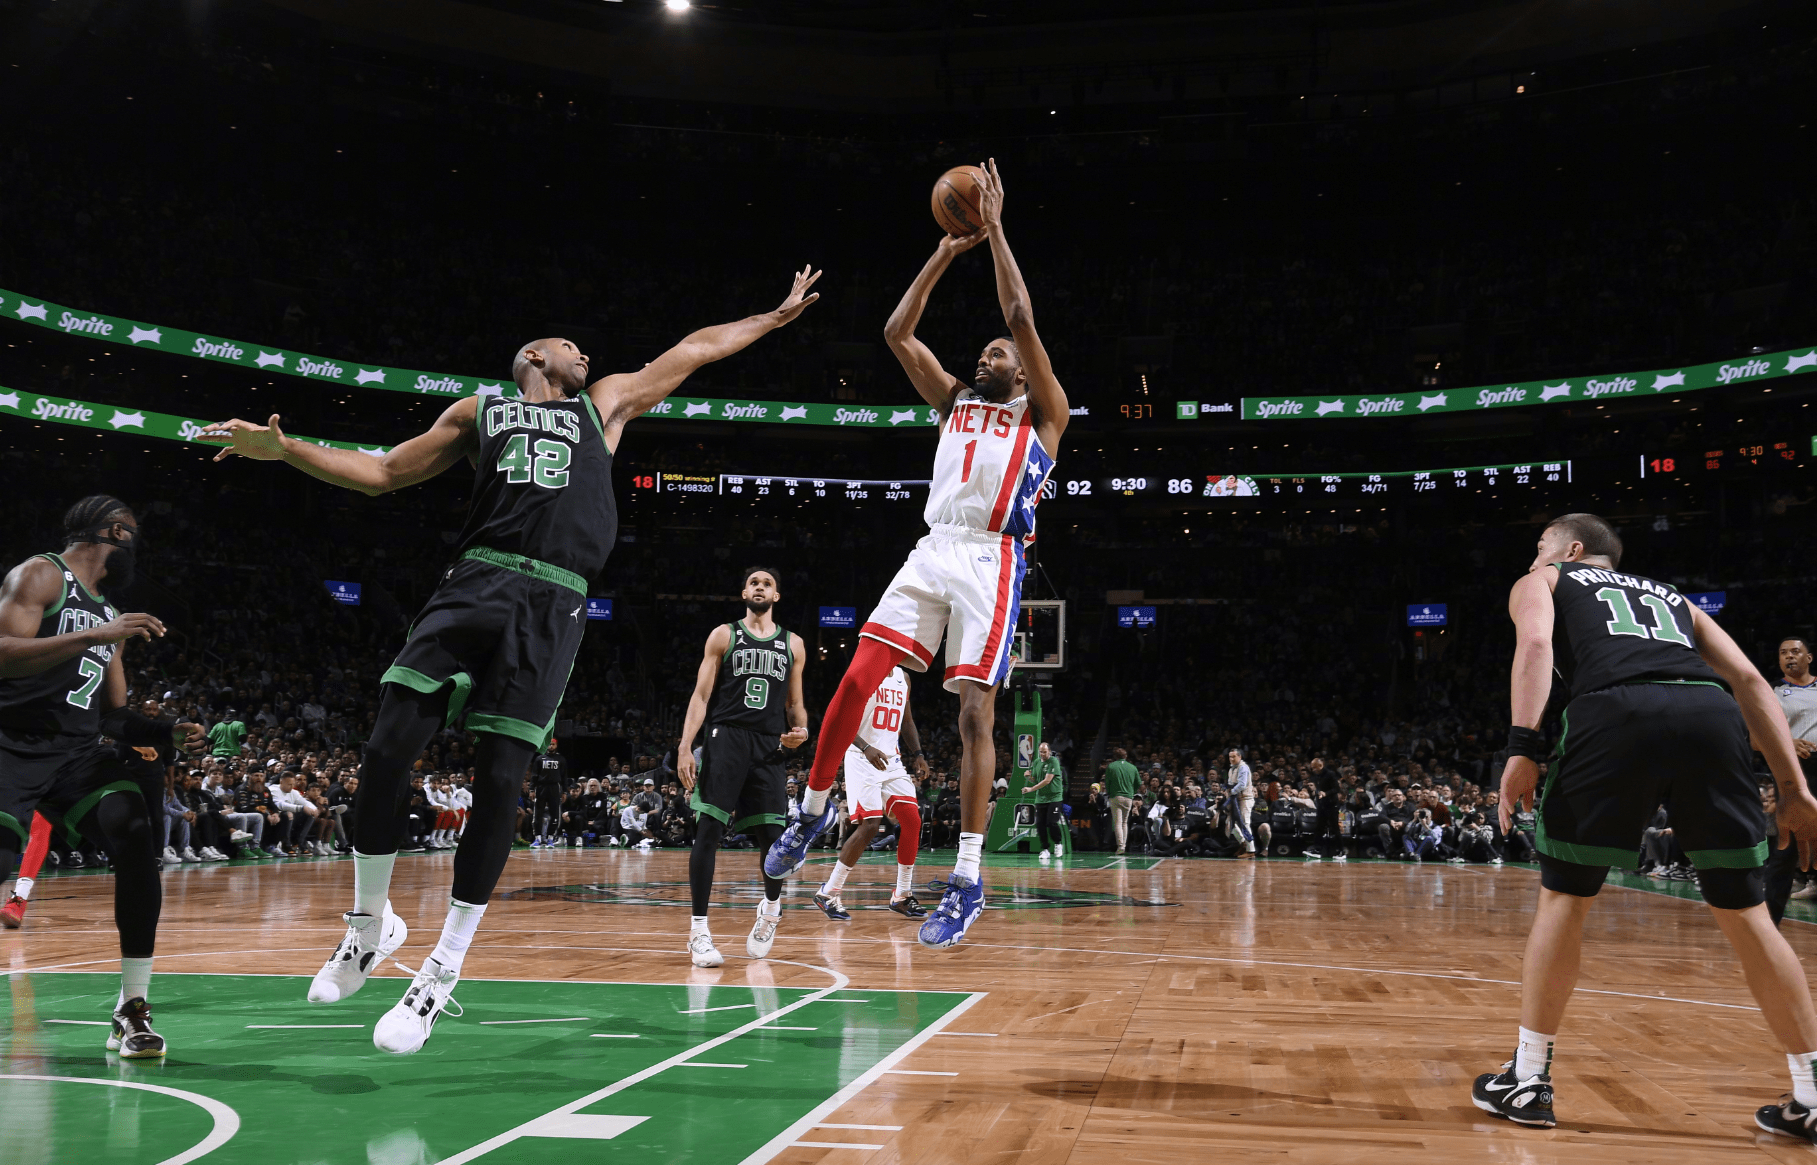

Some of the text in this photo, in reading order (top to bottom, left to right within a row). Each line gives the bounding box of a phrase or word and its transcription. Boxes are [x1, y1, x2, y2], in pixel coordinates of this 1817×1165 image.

[58, 311, 113, 336] Sprite
[192, 337, 243, 360] Sprite
[295, 357, 344, 379] Sprite
[1716, 359, 1771, 384] Sprite
[414, 374, 464, 394] Sprite
[1583, 377, 1637, 398] Sprite
[1355, 397, 1405, 416] Sprite
[1475, 387, 1527, 407] Sprite
[31, 398, 94, 422] Sprite
[721, 402, 768, 420] Sprite
[833, 408, 879, 425] Sprite
[1069, 406, 1090, 416] ank
[1120, 404, 1152, 418] 9:37
[1181, 403, 1234, 416] TD Bank
[1255, 400, 1304, 418] Sprite
[486, 402, 580, 444] CELTICS
[949, 404, 1014, 439] NETS
[496, 433, 572, 489] 42
[960, 439, 978, 483] 1
[1739, 445, 1764, 457] 9:30
[1321, 475, 1342, 483] FG%
[1369, 474, 1382, 483] FG
[1414, 472, 1430, 480] 3PT
[1453, 470, 1466, 478] TO
[1483, 467, 1499, 476] STL
[1513, 465, 1532, 474] AST
[1543, 463, 1562, 472] REB
[1650, 458, 1675, 473] 18
[633, 475, 654, 489] 18
[667, 483, 713, 493] C-1498320
[727, 476, 744, 484] REB
[785, 479, 799, 487] STL
[813, 480, 826, 488] TO
[846, 481, 862, 489] 3PT
[890, 482, 902, 490] FG
[1066, 480, 1092, 495] 92
[1111, 477, 1147, 491] 9:30
[1167, 479, 1193, 494] 86
[1273, 472, 1560, 494] 3 0 48 34/71 7/25 14 6 22 40
[730, 485, 911, 501] 40 23 6 10 11/35 32/78
[1567, 568, 1683, 607] PRITCHARD
[1595, 586, 1693, 649] 11
[732, 648, 788, 681] CELTICS
[66, 656, 104, 710] 7
[743, 677, 769, 710] 9
[875, 687, 904, 707] NETS
[872, 705, 901, 732] 00
[541, 760, 559, 770] NETS
